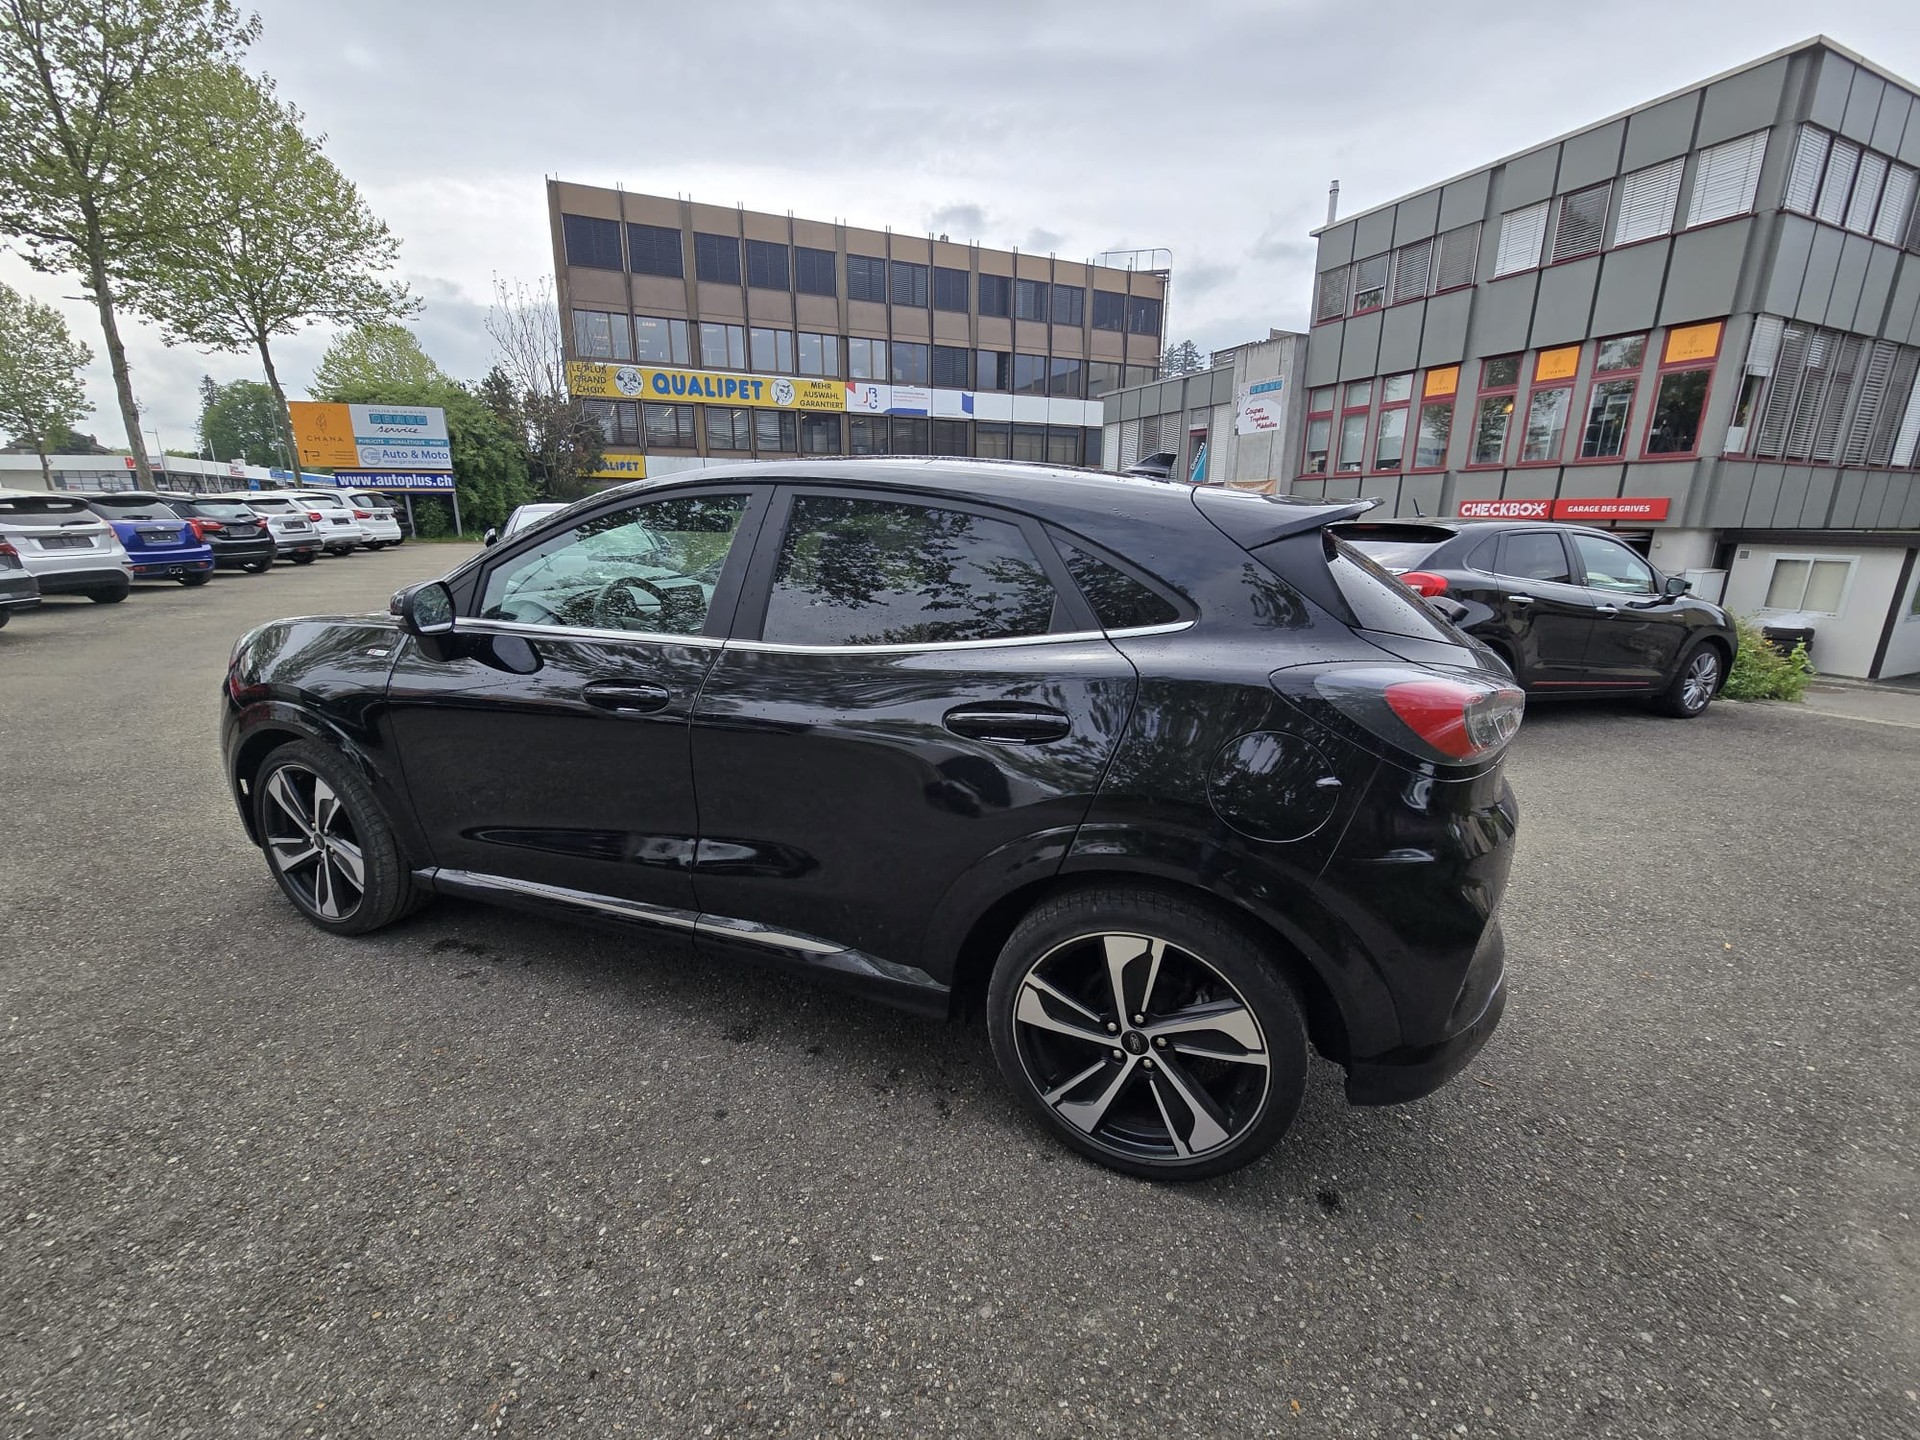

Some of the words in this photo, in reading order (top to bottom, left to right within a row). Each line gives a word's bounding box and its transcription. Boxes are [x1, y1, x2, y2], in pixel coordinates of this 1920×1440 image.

[574, 375, 606, 383] GRAND
[577, 386, 606, 394] CHOIX
[652, 373, 763, 400] QUALIPET
[810, 382, 832, 390] MEHR
[803, 391, 840, 399] AUSWAHL
[800, 400, 844, 408] GARANTIERT
[1245, 407, 1264, 415] Coupes
[382, 450, 408, 459] Auto
[411, 450, 419, 459] &
[421, 451, 449, 460] Moto
[337, 474, 453, 488] www.autoplus.ch
[1461, 503, 1547, 516] CHECKBOX
[1567, 505, 1600, 513] GARAGE
[1600, 505, 1617, 513] DES
[1618, 505, 1651, 513] GRIVES
